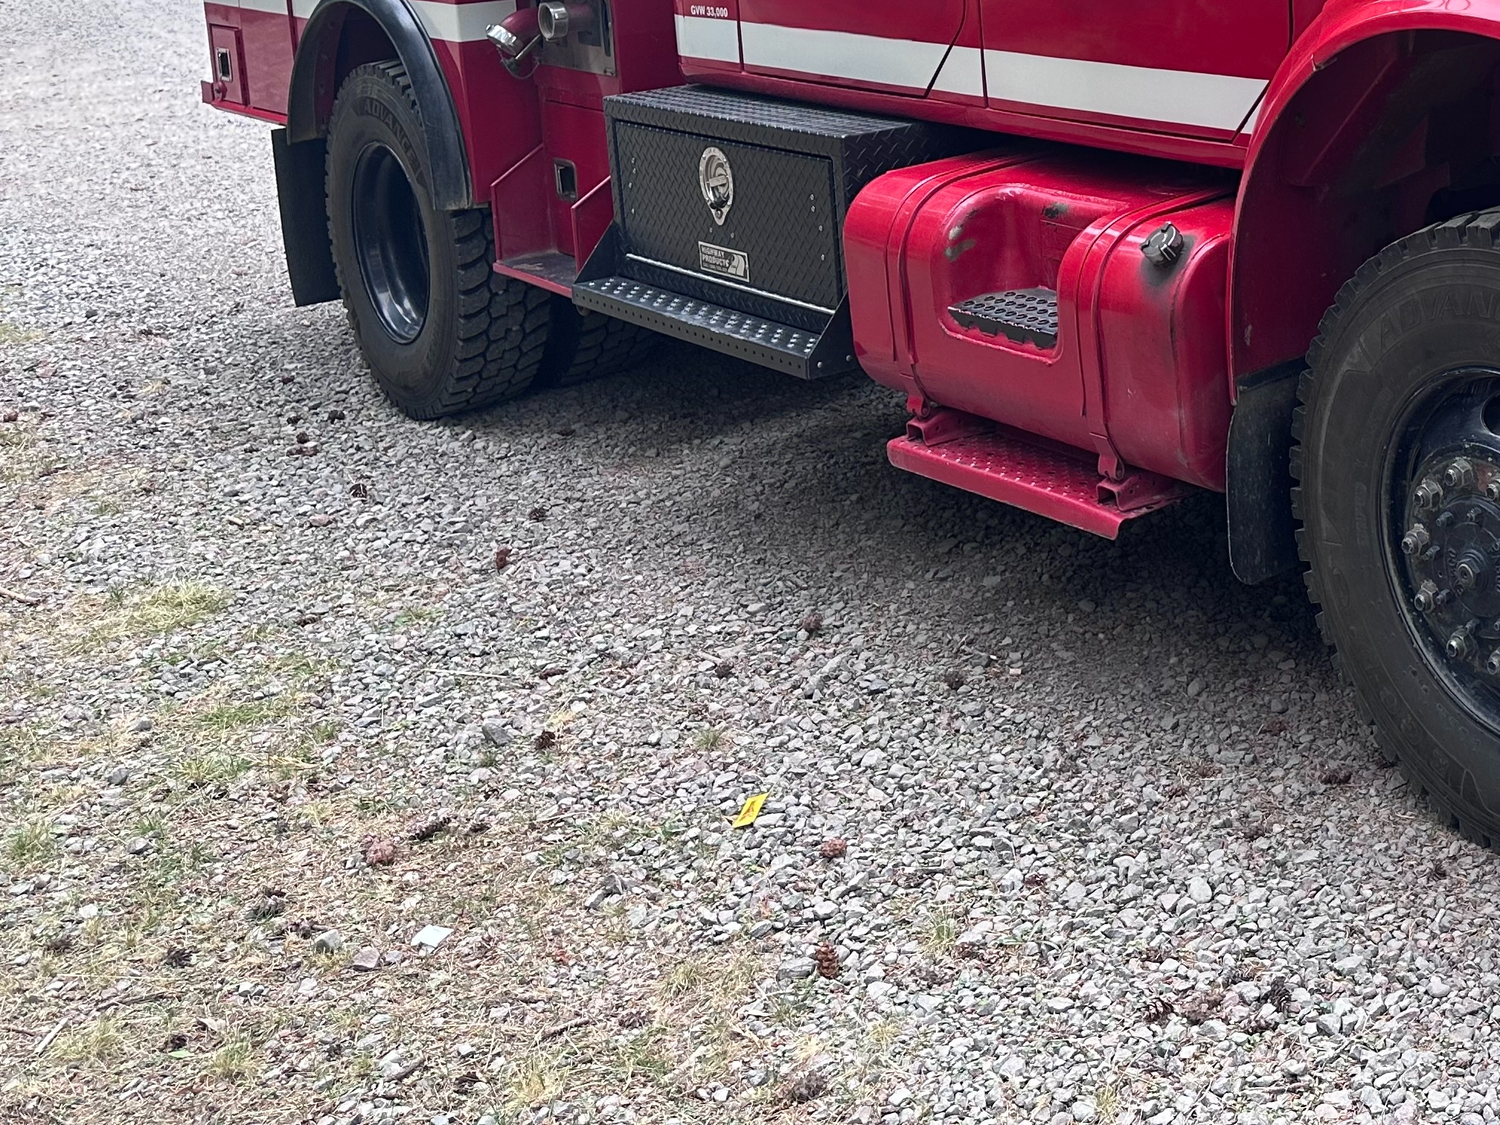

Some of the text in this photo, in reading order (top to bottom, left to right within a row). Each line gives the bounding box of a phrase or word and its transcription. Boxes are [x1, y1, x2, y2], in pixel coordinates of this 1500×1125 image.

[690, 5, 729, 19] GVW 33,000
[363, 97, 417, 165] ADVANCE
[702, 254, 730, 267] PRODUCTS
